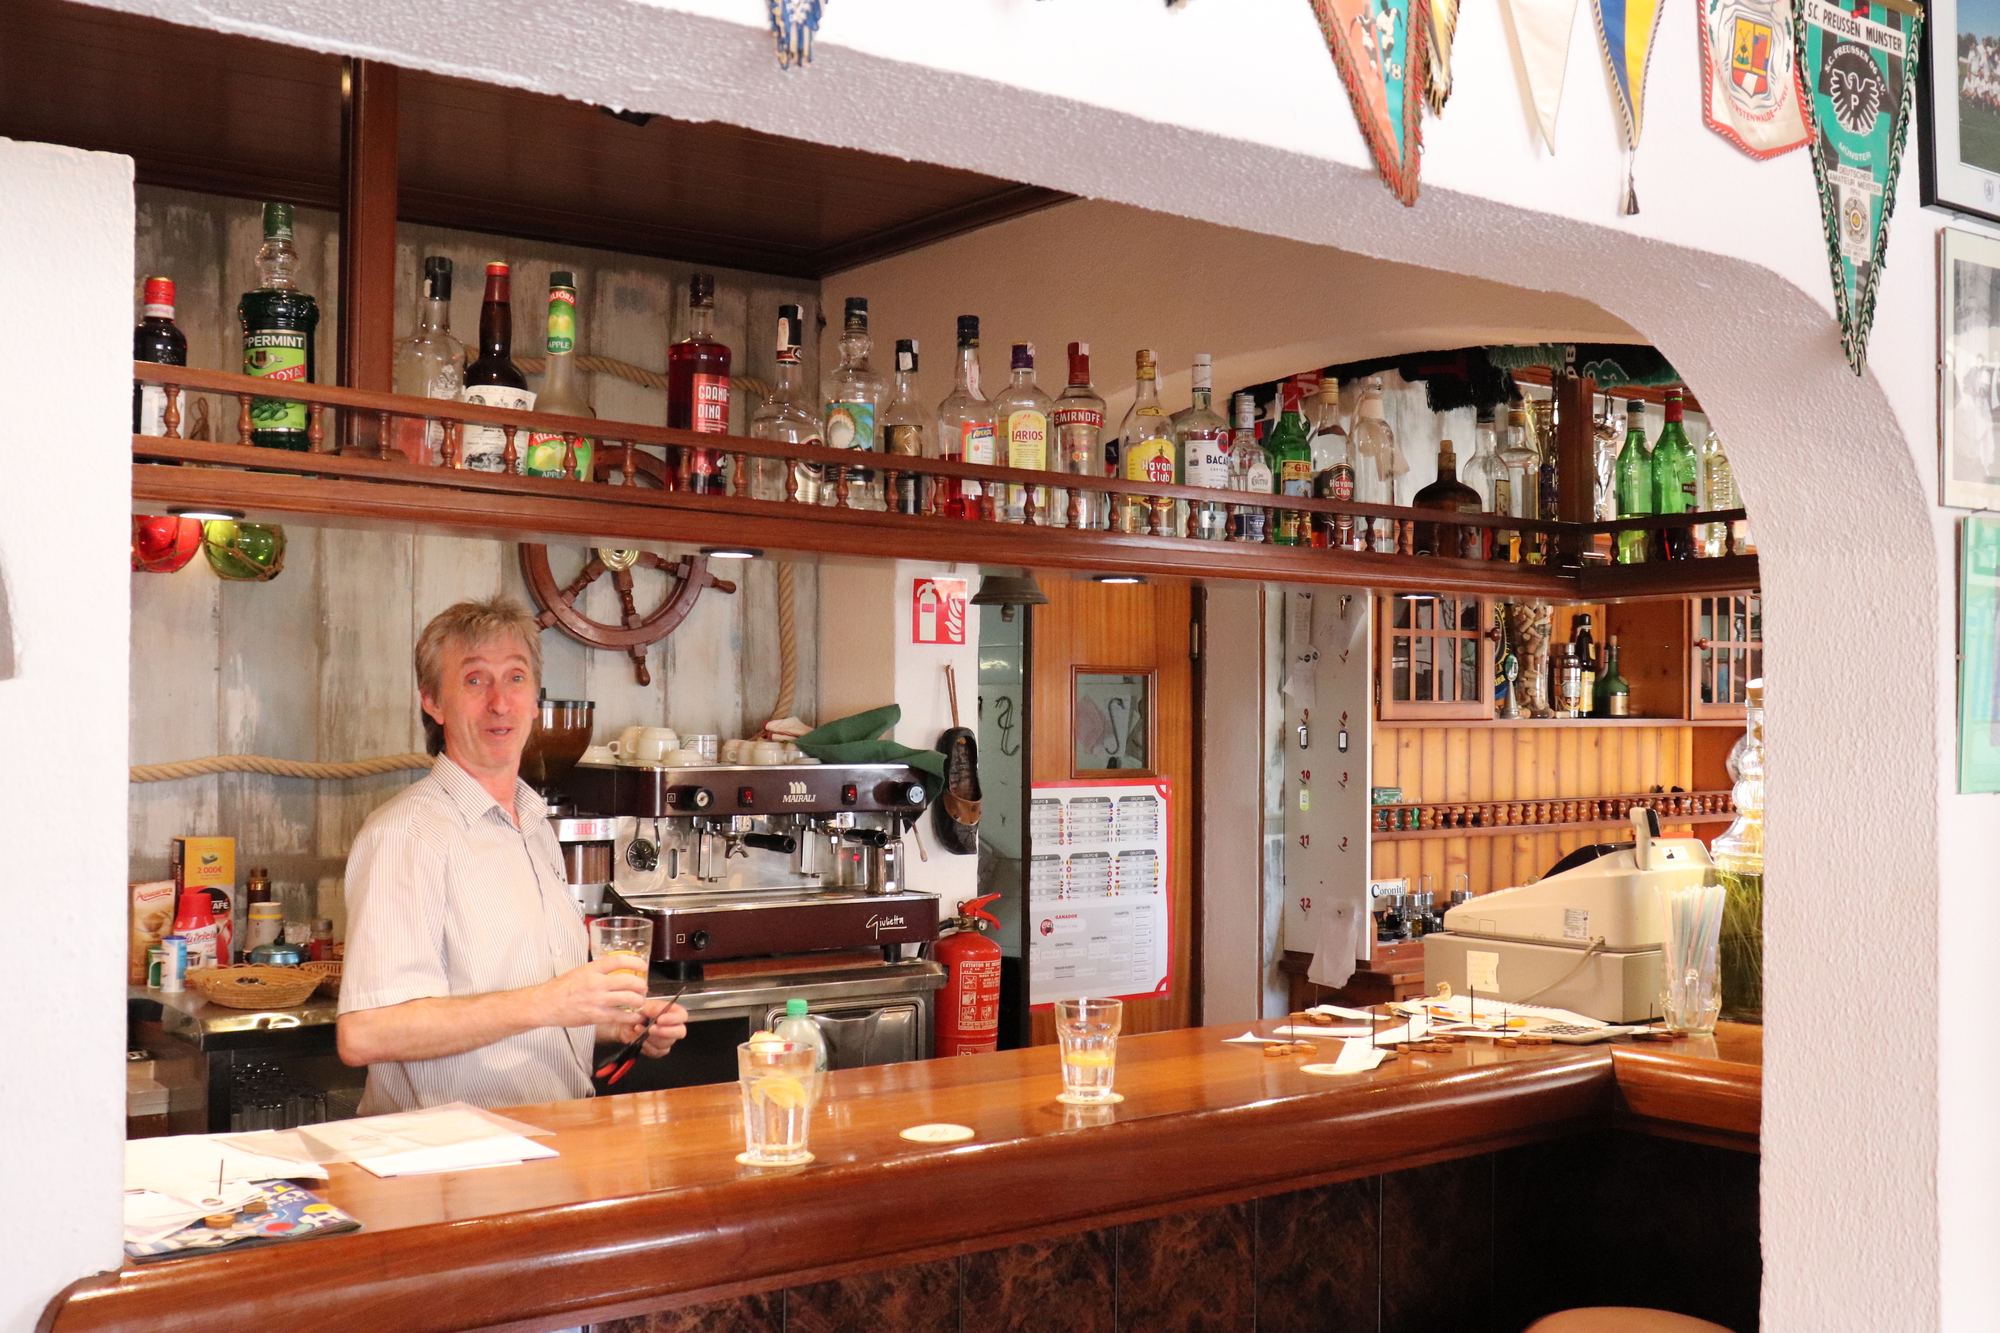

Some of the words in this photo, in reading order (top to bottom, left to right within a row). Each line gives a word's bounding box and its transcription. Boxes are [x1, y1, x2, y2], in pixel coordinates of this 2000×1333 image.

[1808, 2, 1820, 20] S.C.
[1823, 9, 1861, 38] PREUSSEN
[1866, 26, 1902, 52] MÜNSTER
[1833, 44, 1869, 62] PREUSSEN
[698, 404, 721, 419] DINA
[1055, 411, 1101, 424] SMIRNOFF
[1012, 430, 1044, 443] LARIOS
[1294, 463, 1311, 473] GIN
[1150, 471, 1170, 483] Club
[1336, 487, 1351, 496] Club
[1301, 770, 1311, 780] 10
[1342, 772, 1348, 782] 3
[782, 794, 816, 803] MAIRALI
[1342, 837, 1348, 847] 2
[212, 900, 230, 910] AFÉ
[866, 914, 907, 940] Giulietta
